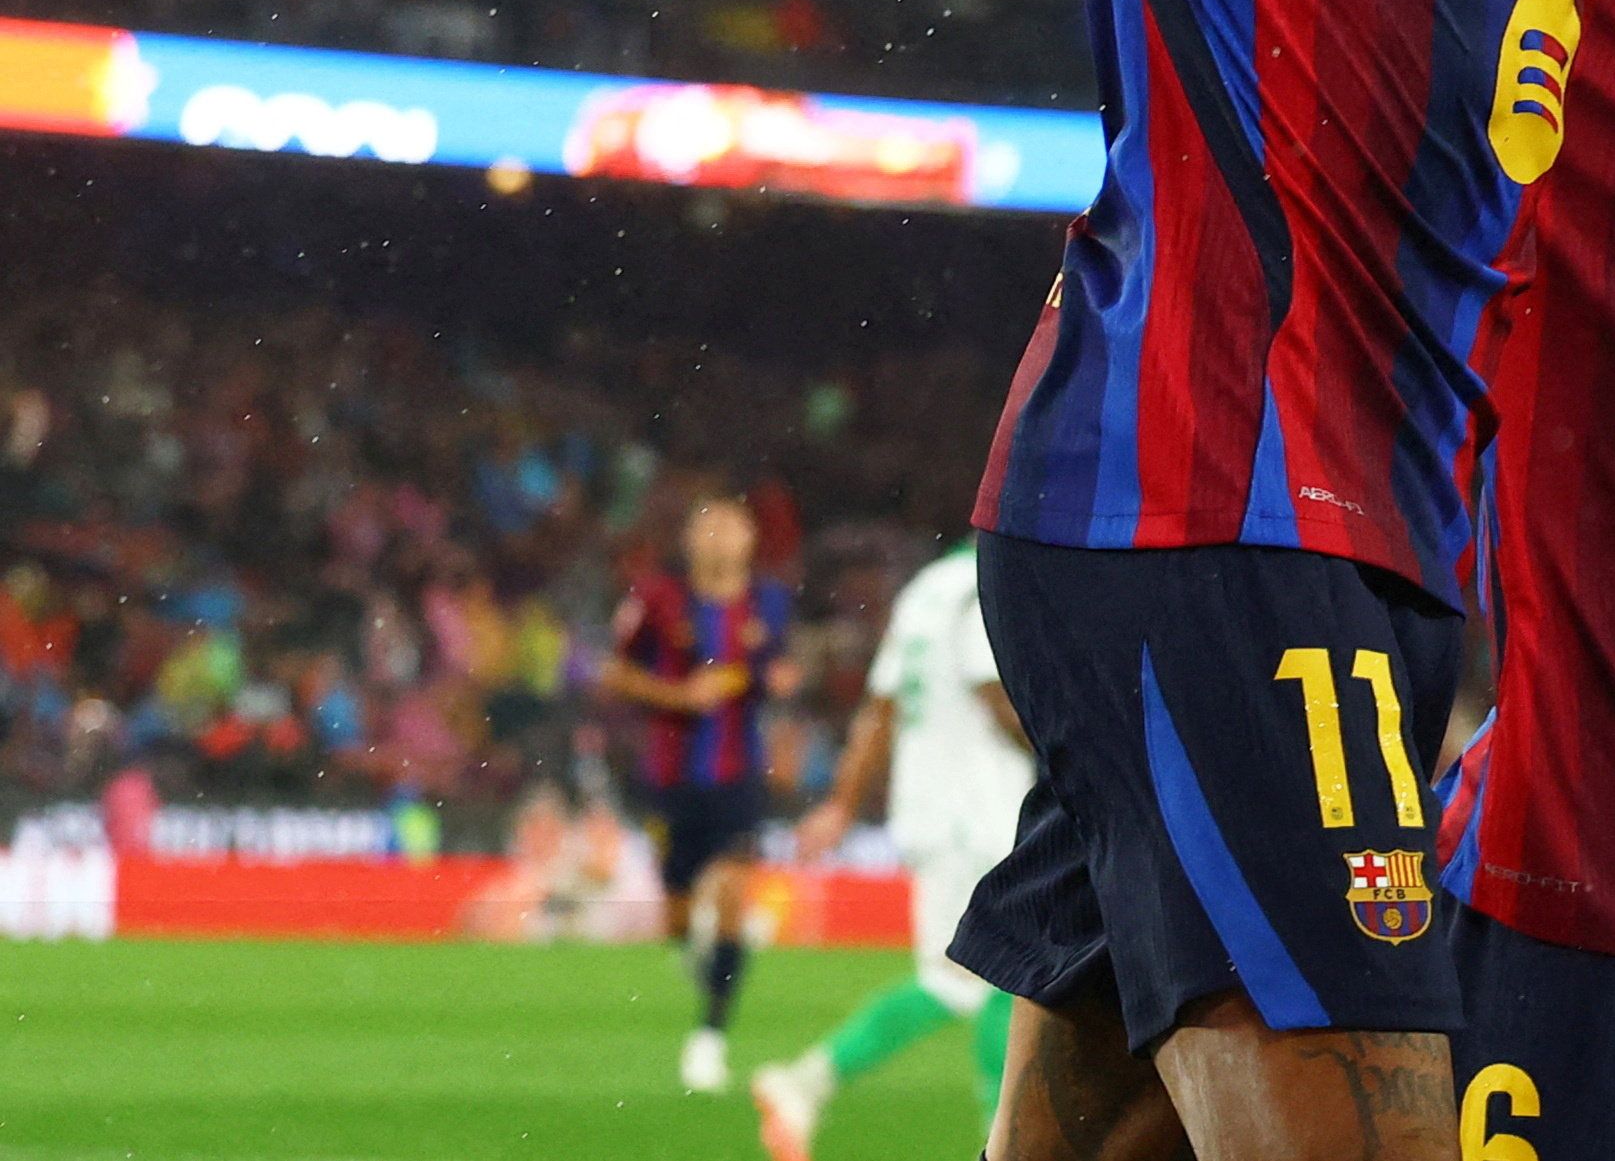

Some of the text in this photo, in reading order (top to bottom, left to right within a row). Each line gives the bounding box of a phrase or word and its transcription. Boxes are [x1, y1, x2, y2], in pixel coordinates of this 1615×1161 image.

[1274, 647, 1425, 829] 11
[1372, 888, 1406, 900] FCB
[1460, 1063, 1541, 1161] 6
